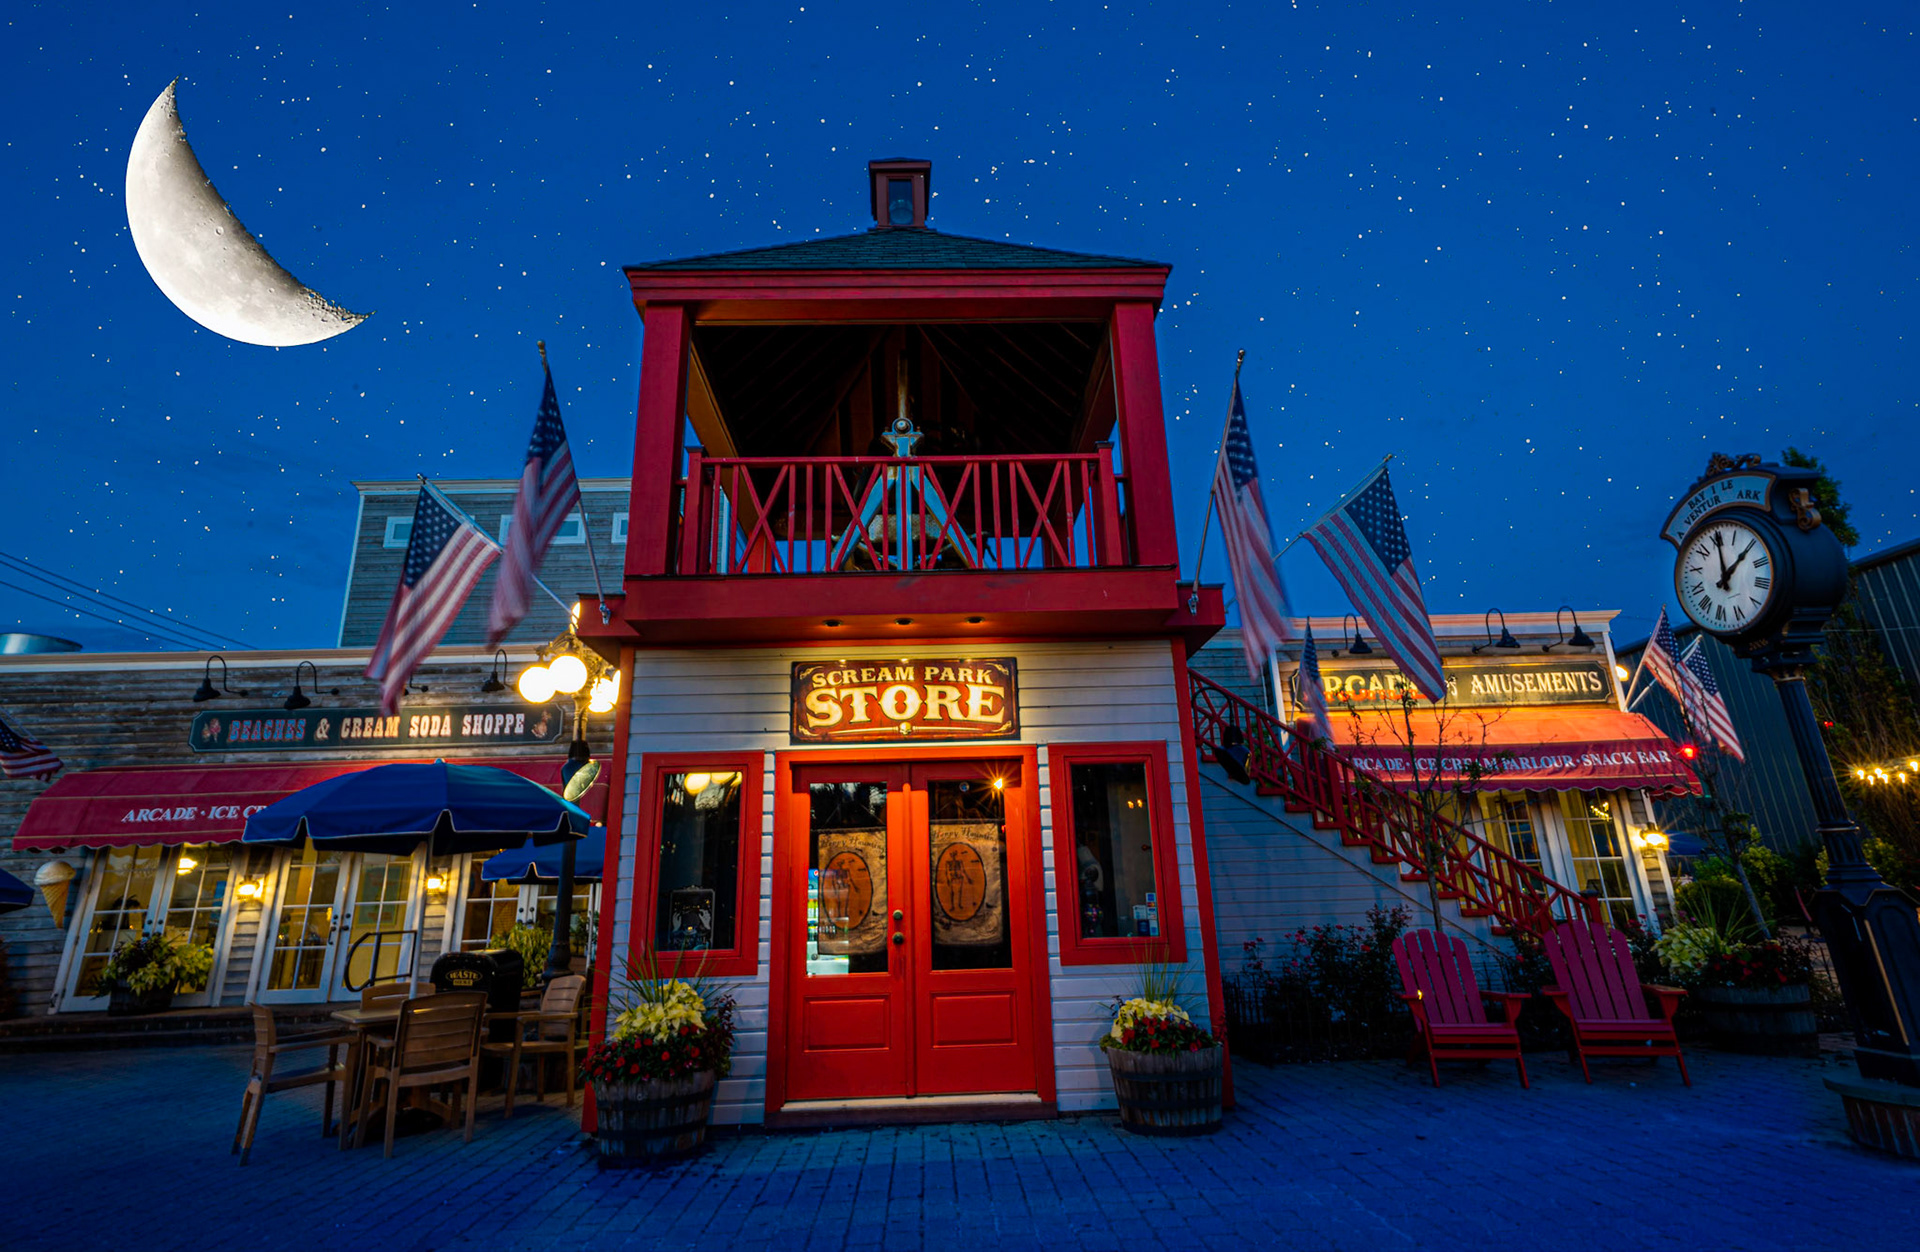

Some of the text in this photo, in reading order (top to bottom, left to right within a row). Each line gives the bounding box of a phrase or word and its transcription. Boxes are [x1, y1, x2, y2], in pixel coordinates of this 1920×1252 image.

[812, 666, 994, 688] SCREAM PARK
[1471, 671, 1602, 695] AMUSEMENTS
[805, 683, 1005, 728] STORE
[227, 713, 526, 742] BEACHES & CREAM SODA SHOPPE
[1346, 757, 1405, 771] RCADE
[1502, 754, 1576, 770] PARLOUR
[1581, 751, 1635, 767] SNACK
[1637, 750, 1672, 765] BAR
[121, 807, 198, 823] ARCADE
[208, 806, 240, 820] ICE
[450, 970, 478, 980] WASTE
